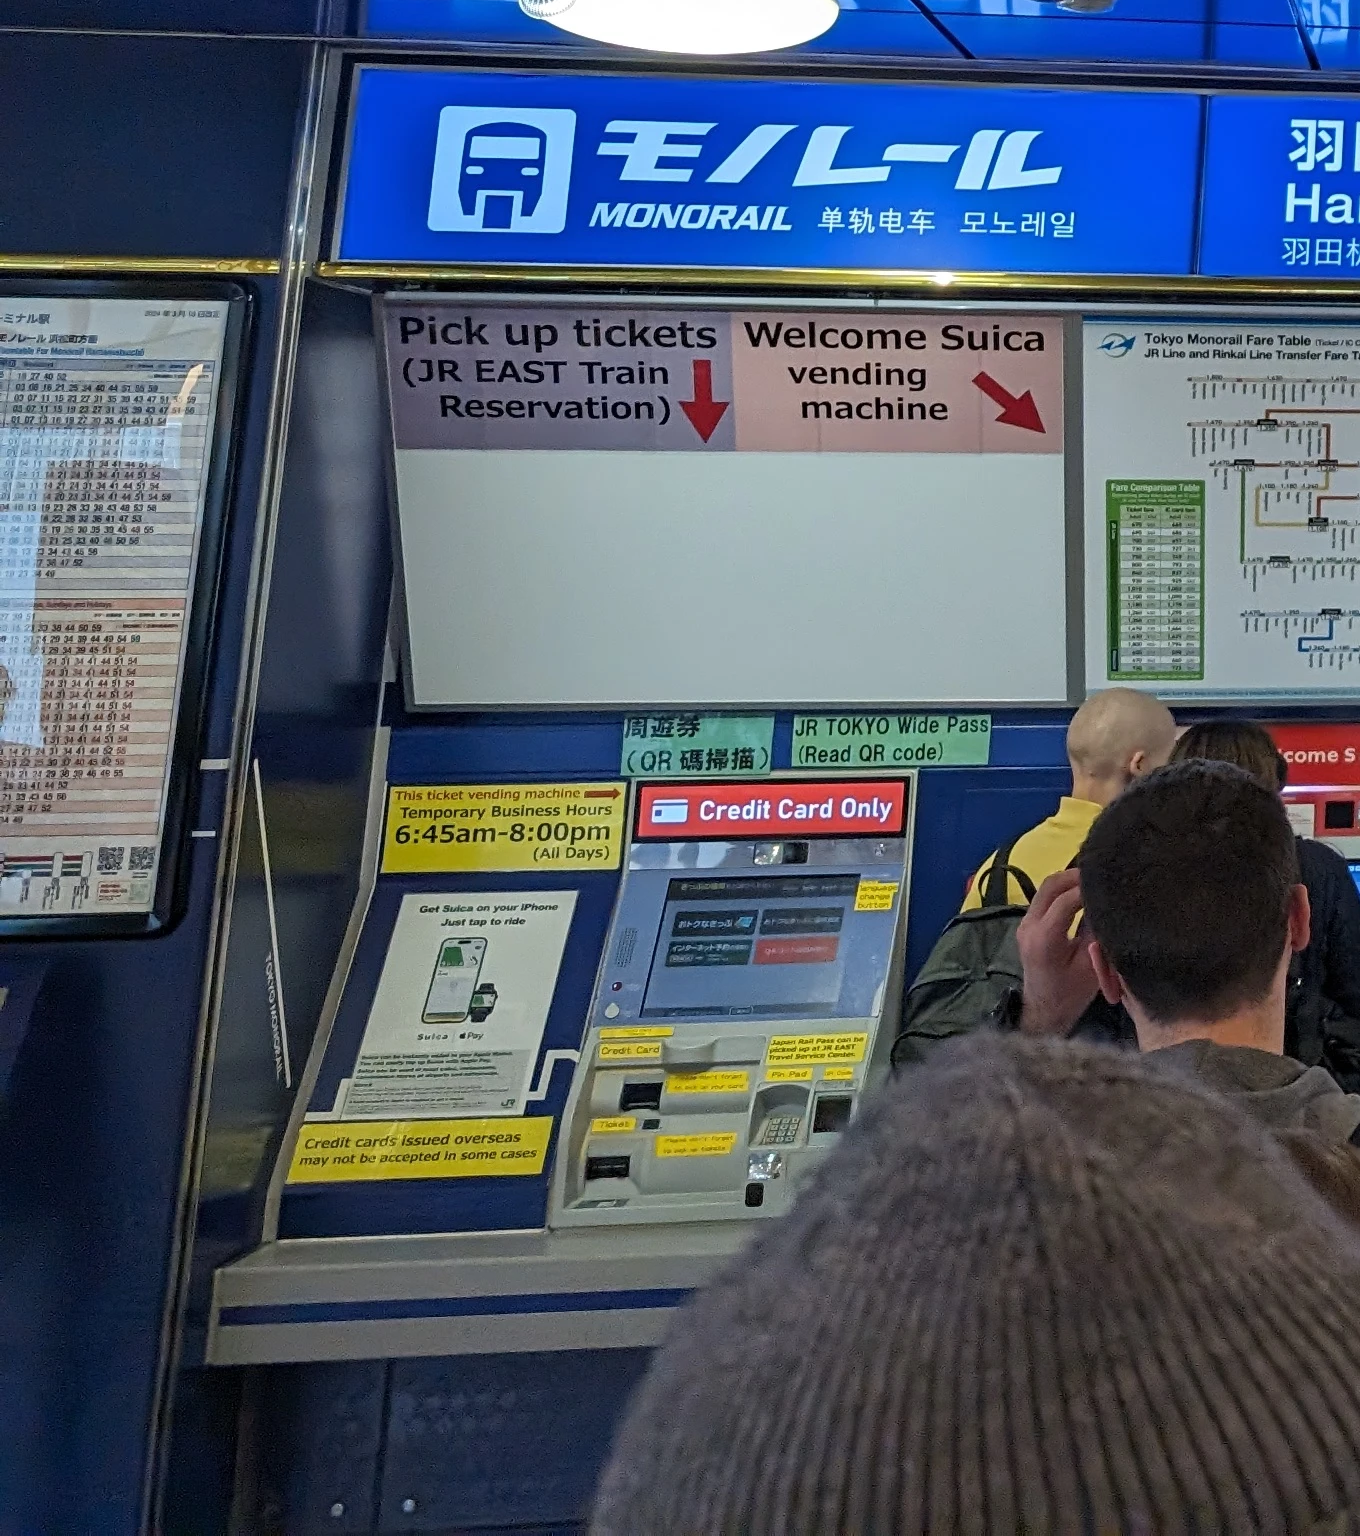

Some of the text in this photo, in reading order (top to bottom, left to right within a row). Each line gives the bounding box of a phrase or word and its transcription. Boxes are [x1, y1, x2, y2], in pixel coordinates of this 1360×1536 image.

[597, 121, 1062, 190] モノレール
[588, 203, 794, 232] MONORAIL
[818, 207, 935, 235] 单轨电车
[960, 212, 1074, 237] 모노레일
[399, 316, 716, 353] Pick up tickets
[744, 322, 1044, 351] Welcome Suica
[1144, 333, 1311, 346] Tokyo Monorail Fare Table
[403, 358, 668, 387] (JR EAST Train
[788, 363, 926, 391] vending
[440, 395, 670, 425] Reservation)
[802, 397, 947, 420] machine
[796, 716, 989, 736] JR TOKYO Wide Pass
[799, 742, 943, 764] (Read QR code)
[395, 789, 580, 801] This ticket vending machine
[400, 804, 612, 821] Temporary Business Hours
[700, 798, 892, 822] Credit Card Only
[396, 823, 609, 845] 6:45am-8:00pm
[534, 846, 609, 862] (All Days)
[305, 1134, 521, 1149] Credit cards issued overseas
[299, 1150, 537, 1167] may not be accepted in some cases
